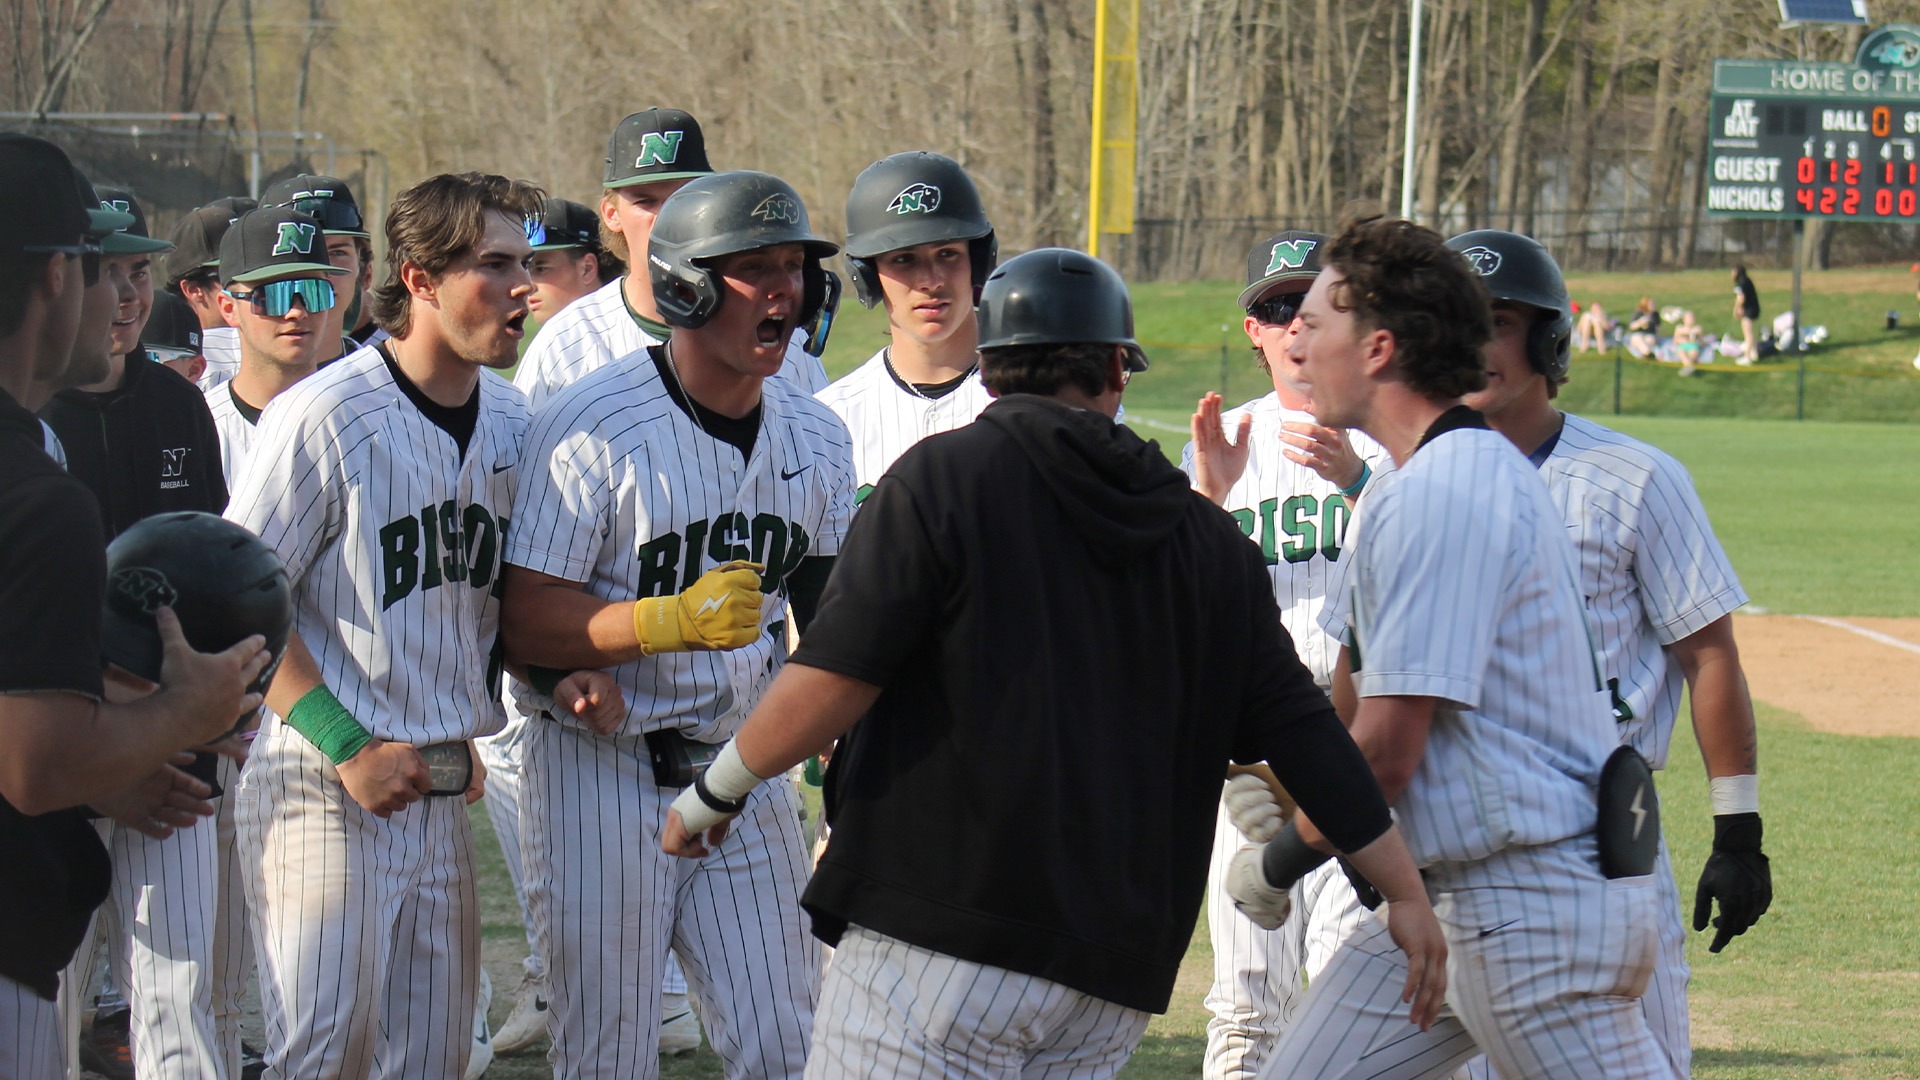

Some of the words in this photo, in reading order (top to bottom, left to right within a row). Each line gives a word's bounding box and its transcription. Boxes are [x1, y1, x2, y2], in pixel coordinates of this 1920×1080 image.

[1771, 68, 1846, 91] HOME
[1852, 69, 1886, 92] OF
[1890, 70, 1920, 92] TH
[1731, 98, 1757, 117] AT
[1822, 109, 1868, 132] BALL
[1872, 105, 1891, 137] 0
[1724, 115, 1760, 137] BAT
[635, 130, 684, 168] N
[1803, 139, 1814, 158] 1
[1823, 140, 1836, 159] 2
[1846, 140, 1859, 159] 3
[1880, 141, 1892, 160] 4
[1714, 156, 1782, 182] GUEST
[1797, 157, 1816, 184] 0
[1829, 160, 1838, 182] 1
[1843, 158, 1862, 185] 2
[1885, 161, 1895, 184] 1
[764, 200, 788, 220] N
[897, 190, 924, 214] N
[1708, 186, 1785, 211] NICHOLS
[1797, 188, 1815, 212] 4
[1819, 187, 1838, 214] 2
[1842, 187, 1861, 215] 2
[1875, 188, 1893, 216] 0
[1898, 189, 1916, 217] 0
[271, 221, 316, 257] N
[1264, 239, 1317, 277] N
[162, 448, 186, 477] N
[160, 479, 190, 490] BASEBALL
[117, 571, 160, 601] N
